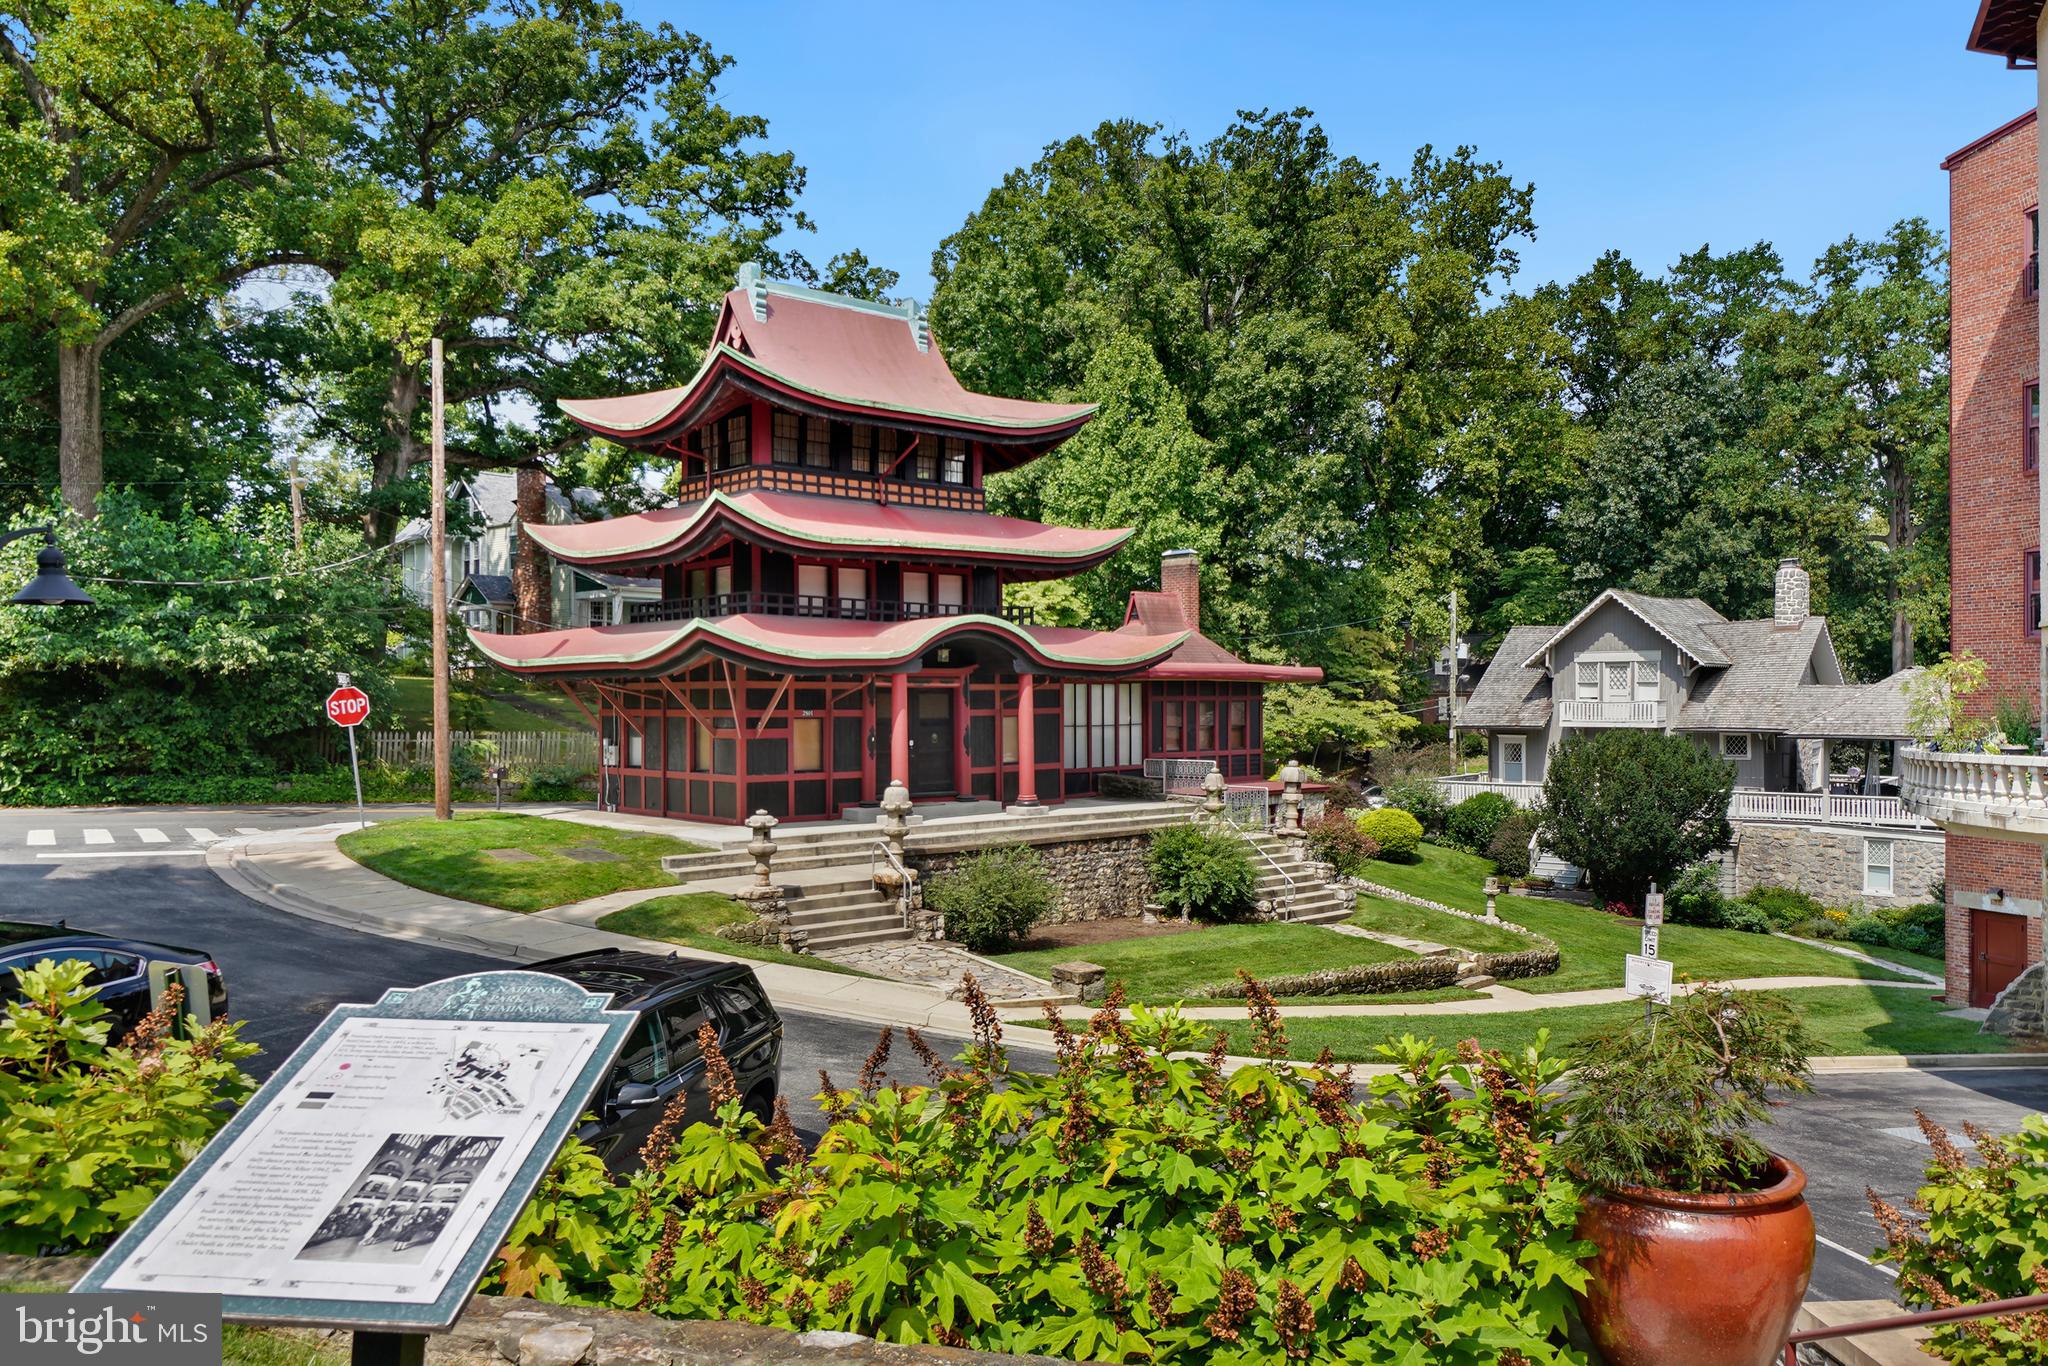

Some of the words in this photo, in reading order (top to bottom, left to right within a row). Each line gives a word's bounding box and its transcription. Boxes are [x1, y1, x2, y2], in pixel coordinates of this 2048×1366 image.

[330, 698, 366, 716] STOP
[1644, 943, 1656, 956] 15
[499, 985, 567, 994] NATIONAL
[490, 994, 524, 1003] PARK
[482, 1004, 554, 1014] SEMINARY
